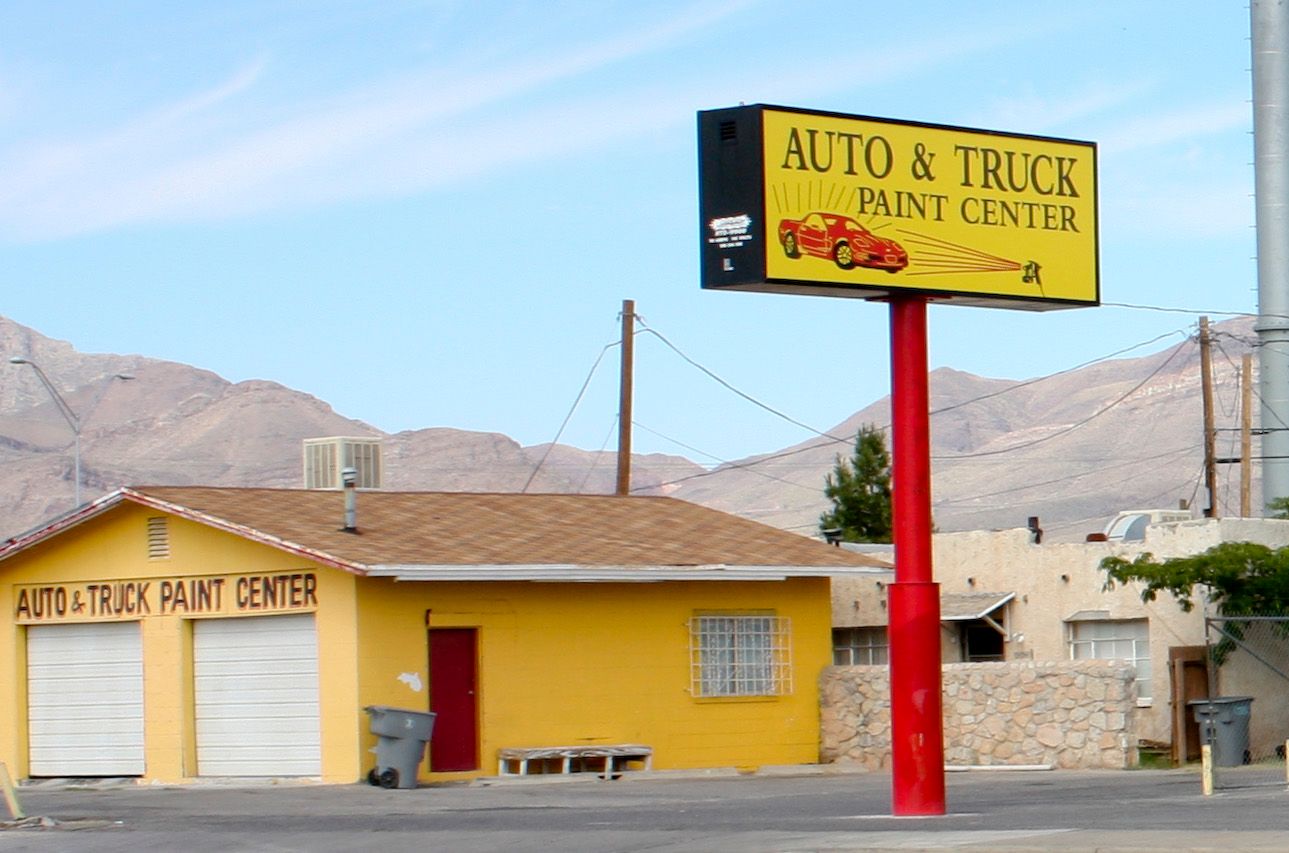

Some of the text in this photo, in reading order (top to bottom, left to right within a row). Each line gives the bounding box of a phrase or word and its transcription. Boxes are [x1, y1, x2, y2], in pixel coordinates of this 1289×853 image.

[781, 127, 1081, 198] AUTO & TRUCK
[857, 186, 1081, 233] PAINT CENTER
[16, 573, 318, 618] AUTO & TRUCK PAINT CENTER
